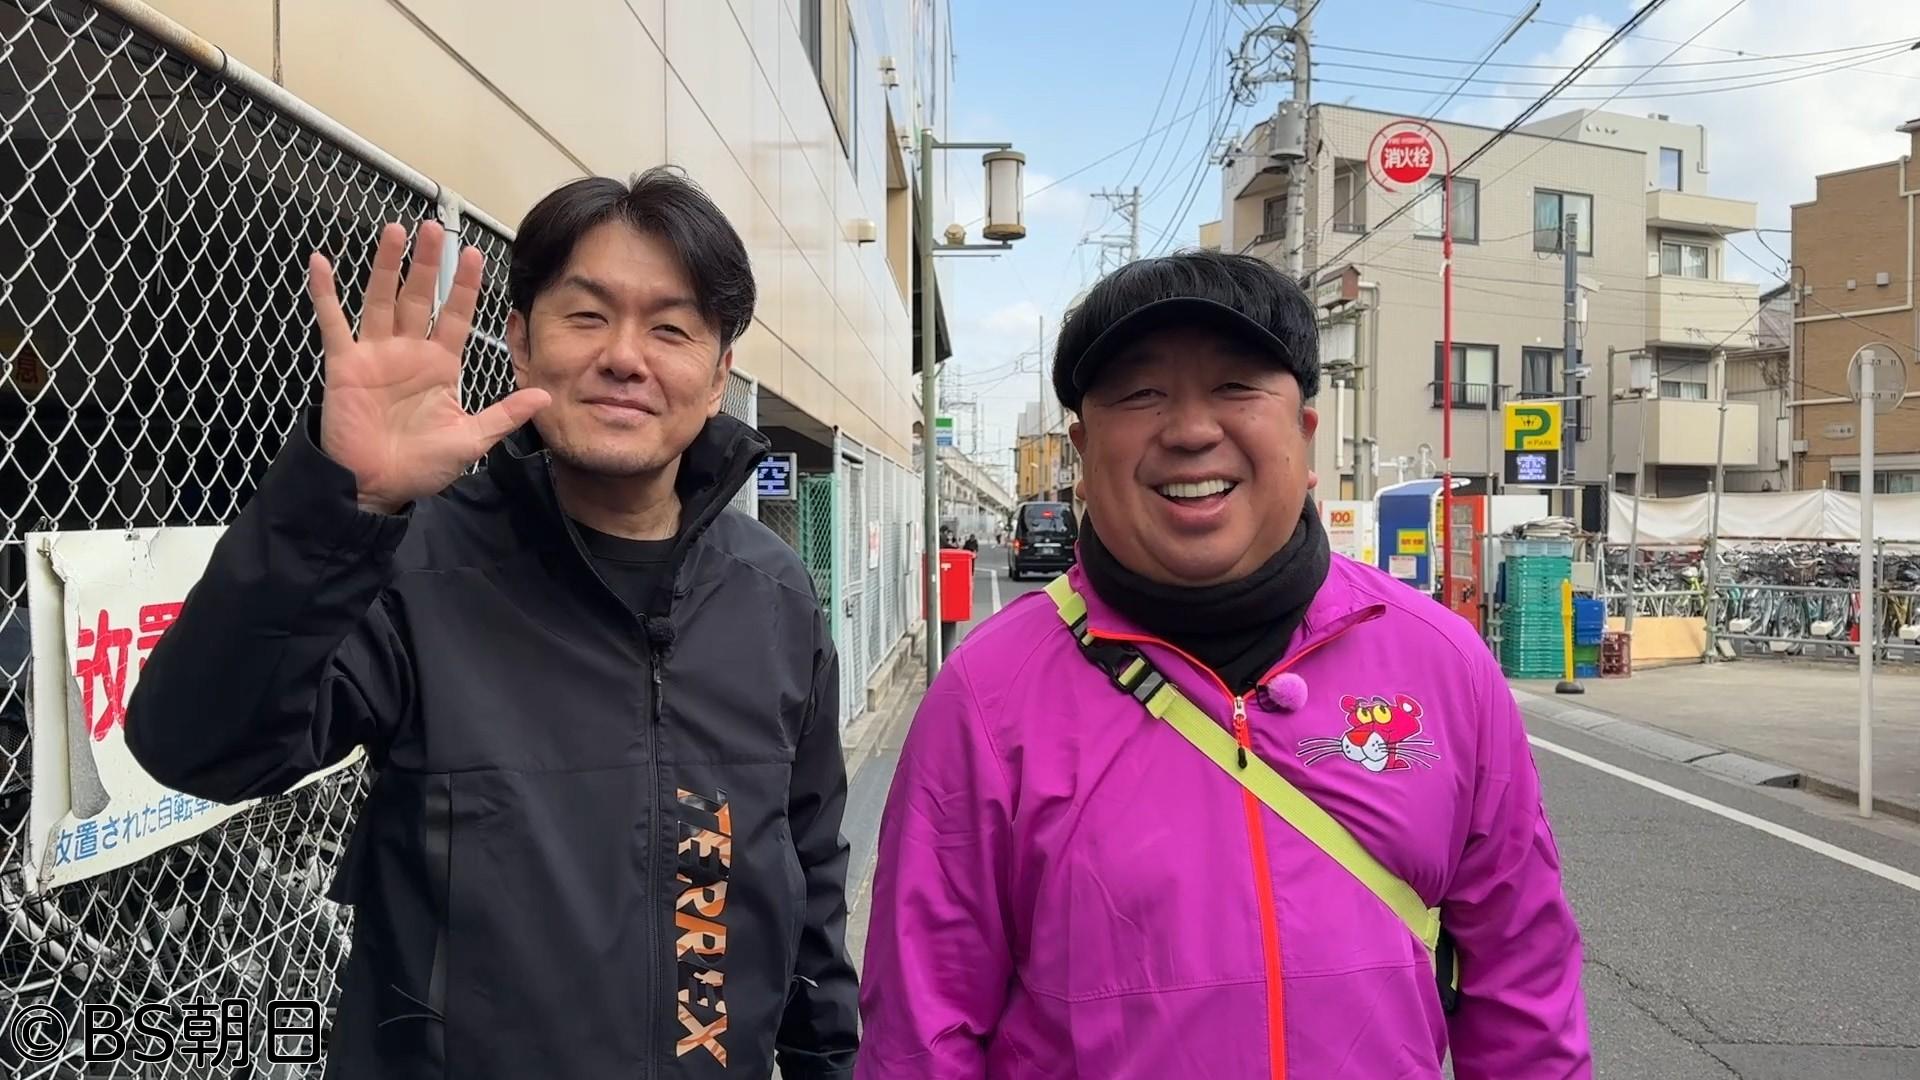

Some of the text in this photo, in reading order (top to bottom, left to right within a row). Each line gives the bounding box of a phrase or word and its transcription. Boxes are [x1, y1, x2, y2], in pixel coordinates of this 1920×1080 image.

[1384, 145, 1430, 169] 消火栓
[1515, 409, 1551, 449] P
[757, 456, 790, 495] 空
[1330, 511, 1351, 523] 100
[675, 788, 732, 1068] TERREX
